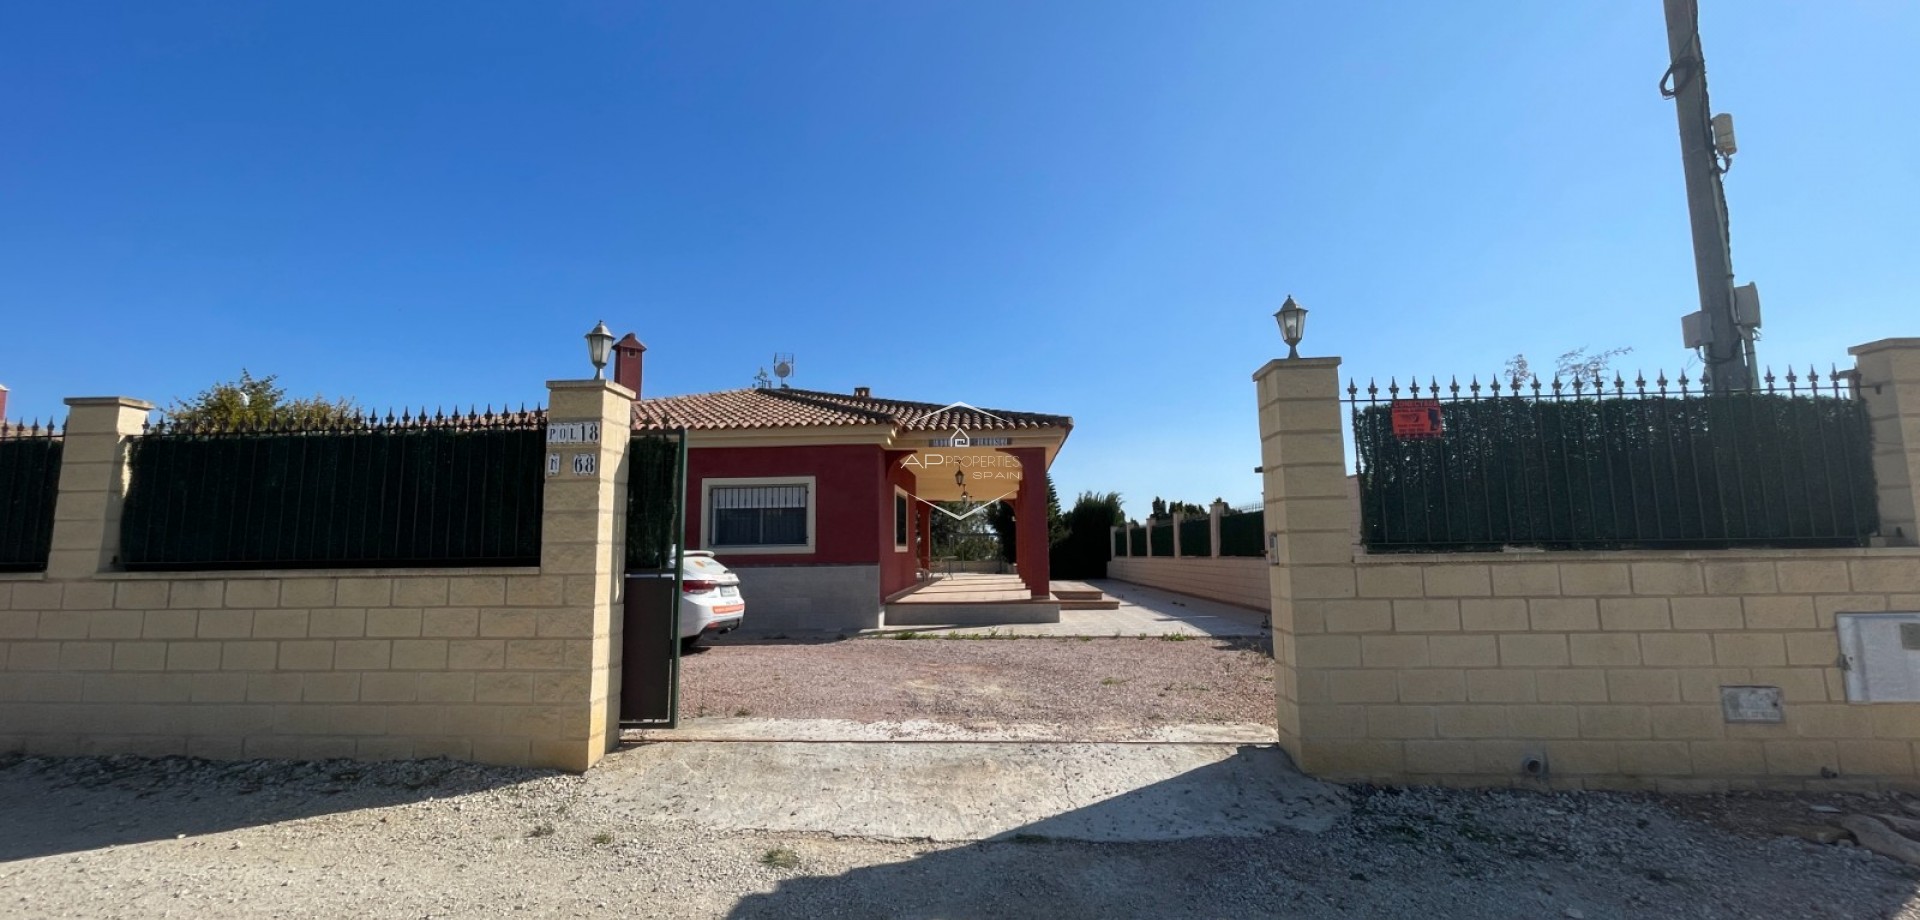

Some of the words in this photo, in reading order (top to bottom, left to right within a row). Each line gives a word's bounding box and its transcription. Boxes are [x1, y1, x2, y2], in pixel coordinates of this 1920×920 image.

[549, 428, 576, 440] POL
[581, 423, 599, 441] 18
[574, 456, 594, 473] 68
